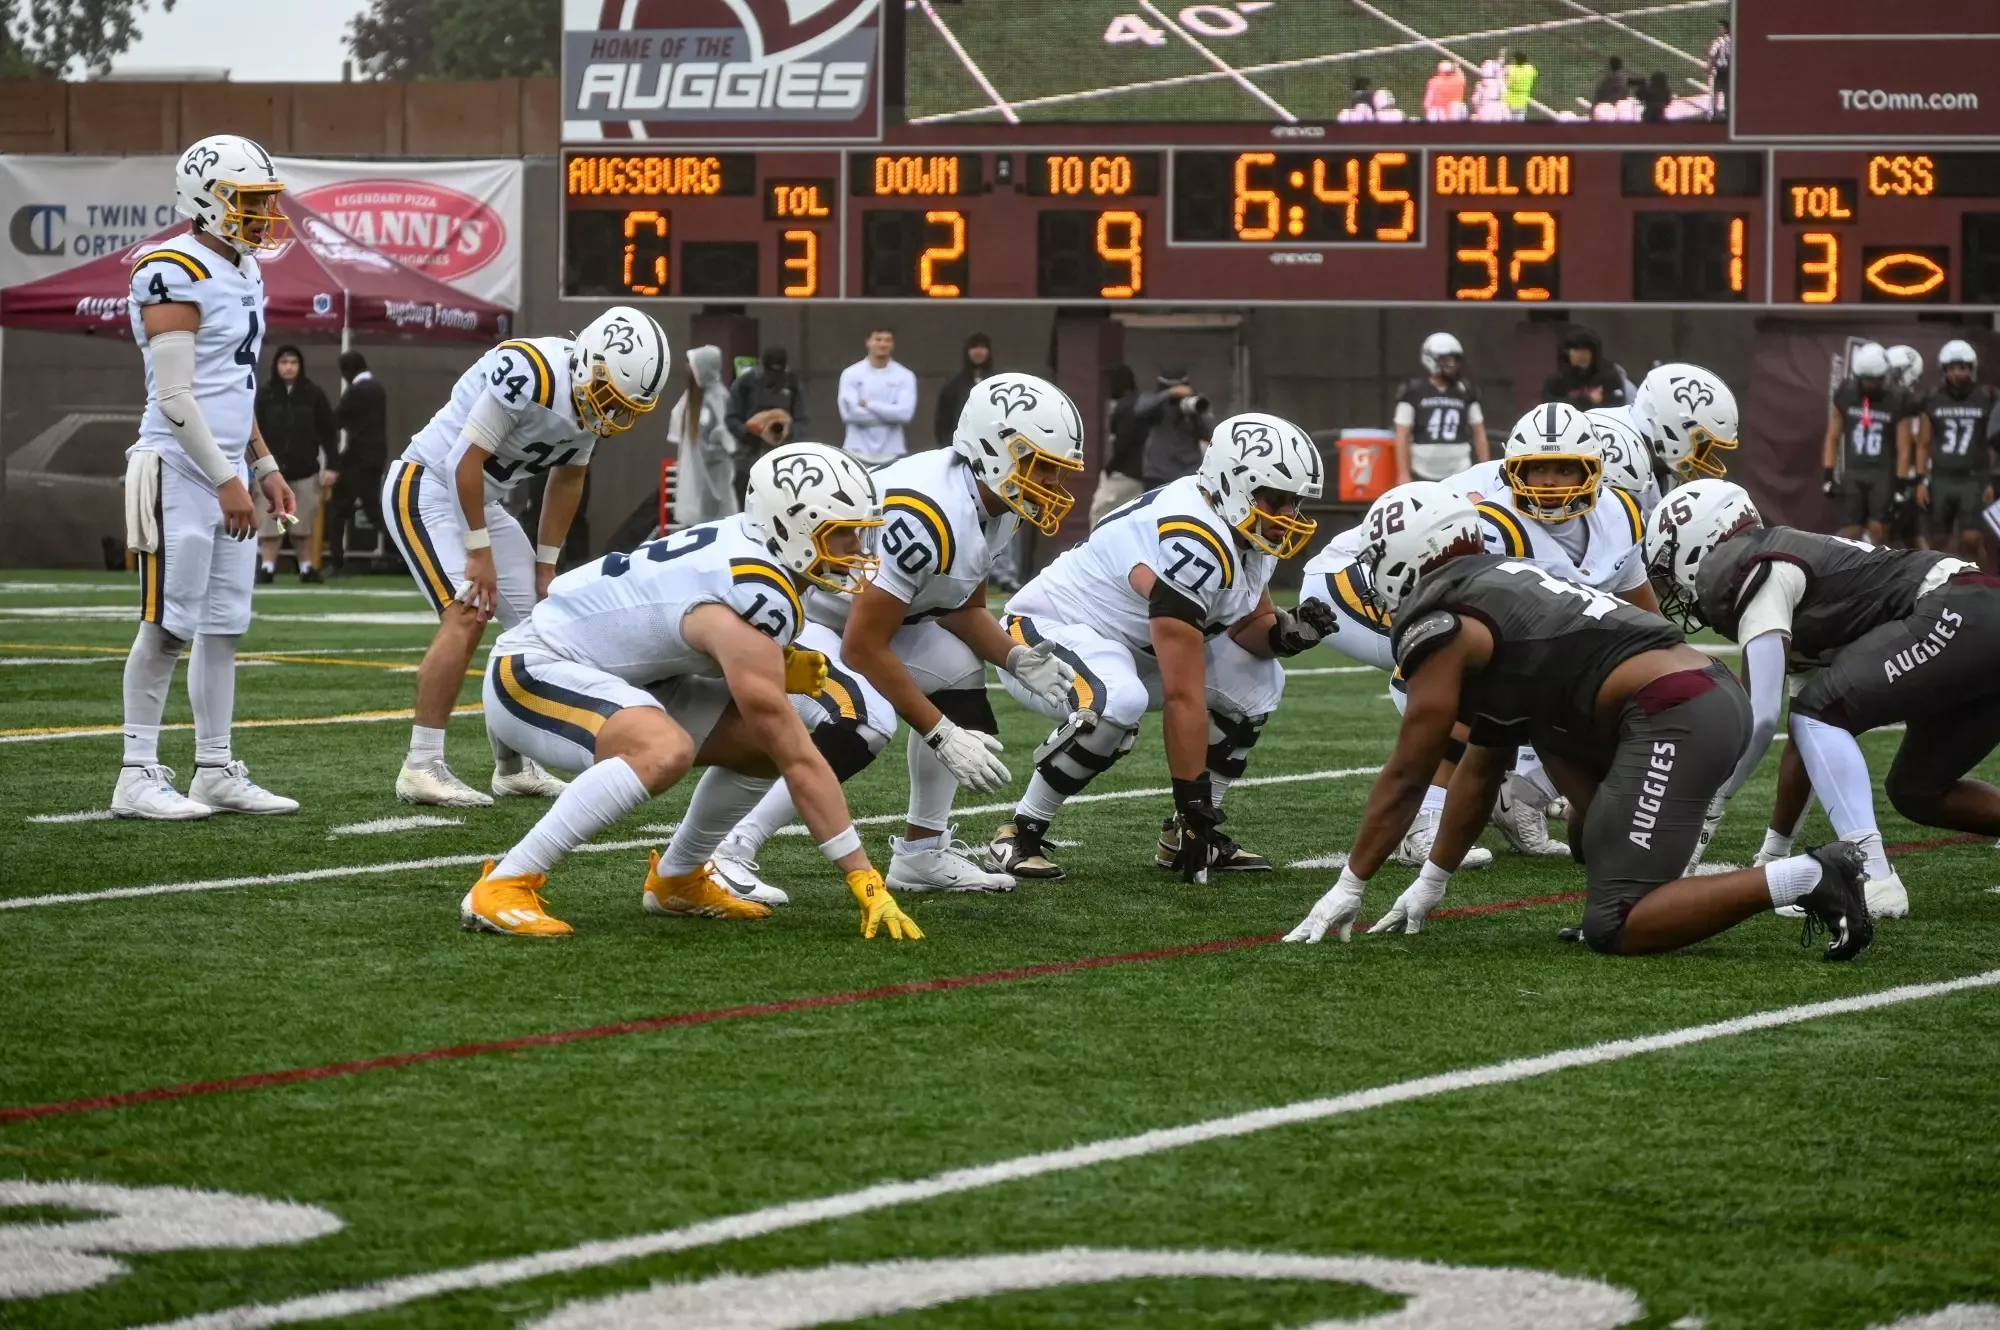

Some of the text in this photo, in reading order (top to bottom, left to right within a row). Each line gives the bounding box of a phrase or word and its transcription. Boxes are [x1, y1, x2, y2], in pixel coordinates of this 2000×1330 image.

[591, 35, 734, 60] HOME OF THE
[577, 61, 868, 110] AUGGIES
[1838, 89, 1979, 111] TCOmn.com
[568, 156, 721, 195] AUGSBURG
[875, 156, 959, 195] DOWN
[1047, 156, 1131, 195] TO GO
[1435, 155, 1570, 195] BALL ON
[1655, 155, 1716, 196] QTR
[1868, 155, 1935, 196] CSS
[87, 204, 147, 228] TWIN
[335, 193, 437, 208] LEGENDARY PIZZA
[774, 185, 829, 217] TOL
[1233, 152, 1415, 241] 6:45
[1791, 187, 1851, 219] TOL
[320, 209, 490, 256] VANNI'S
[784, 230, 817, 297] 3
[920, 210, 965, 297] 2
[1096, 210, 1142, 298] 9
[1455, 211, 1556, 300] 32
[1729, 217, 1745, 292] 1
[1801, 232, 1838, 303] 3
[75, 296, 129, 321] Augs
[147, 272, 173, 304] 4
[234, 310, 260, 390] 4
[490, 355, 529, 404] 34
[1427, 407, 1461, 441] 40
[1940, 418, 1975, 456] 37
[1540, 444, 1561, 452] SAINTS
[1369, 501, 1405, 542] 32
[1658, 495, 1693, 535] 45
[881, 516, 933, 575] 50
[1163, 541, 1217, 594] 77
[742, 592, 788, 638] 12
[1884, 607, 1964, 684] AUGGIES
[1629, 741, 1676, 851] AUGGIES
